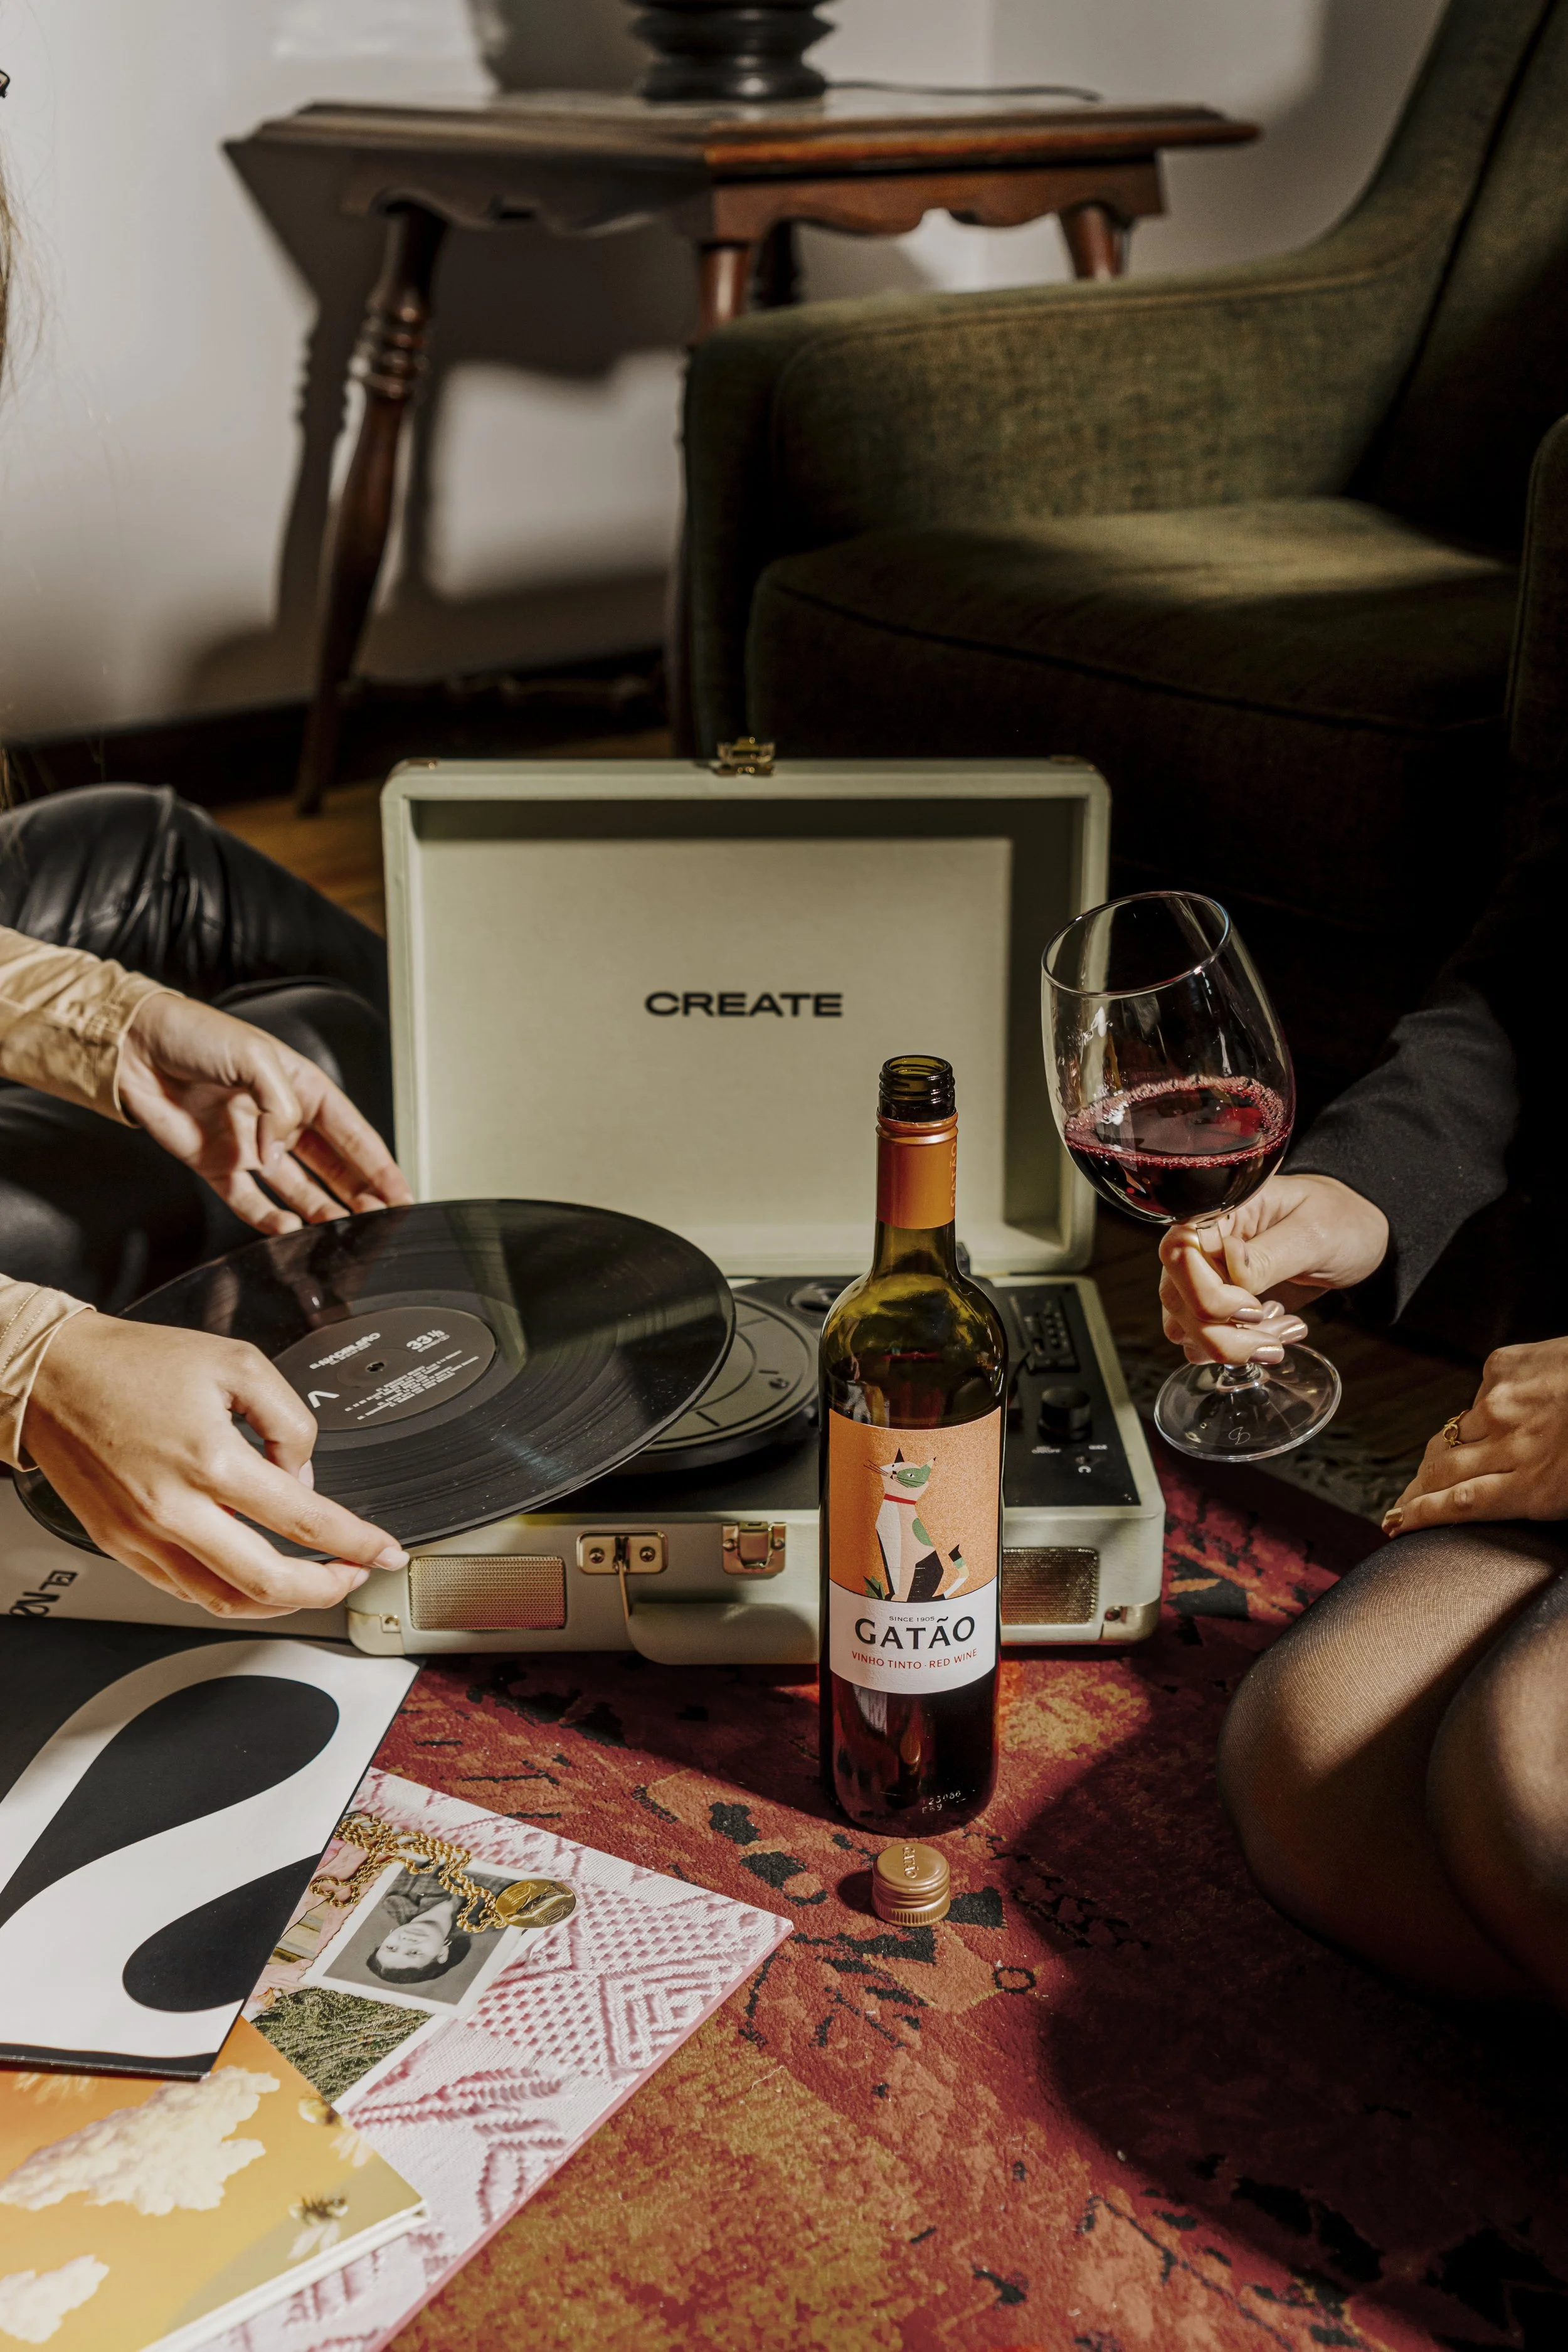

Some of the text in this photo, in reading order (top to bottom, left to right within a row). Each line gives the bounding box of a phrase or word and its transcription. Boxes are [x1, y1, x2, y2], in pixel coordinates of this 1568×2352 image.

[645, 991, 843, 1018] CREATE
[855, 1616, 975, 1650] GATÃO
[852, 1648, 977, 1670] VINHO TINTO RED WINE
